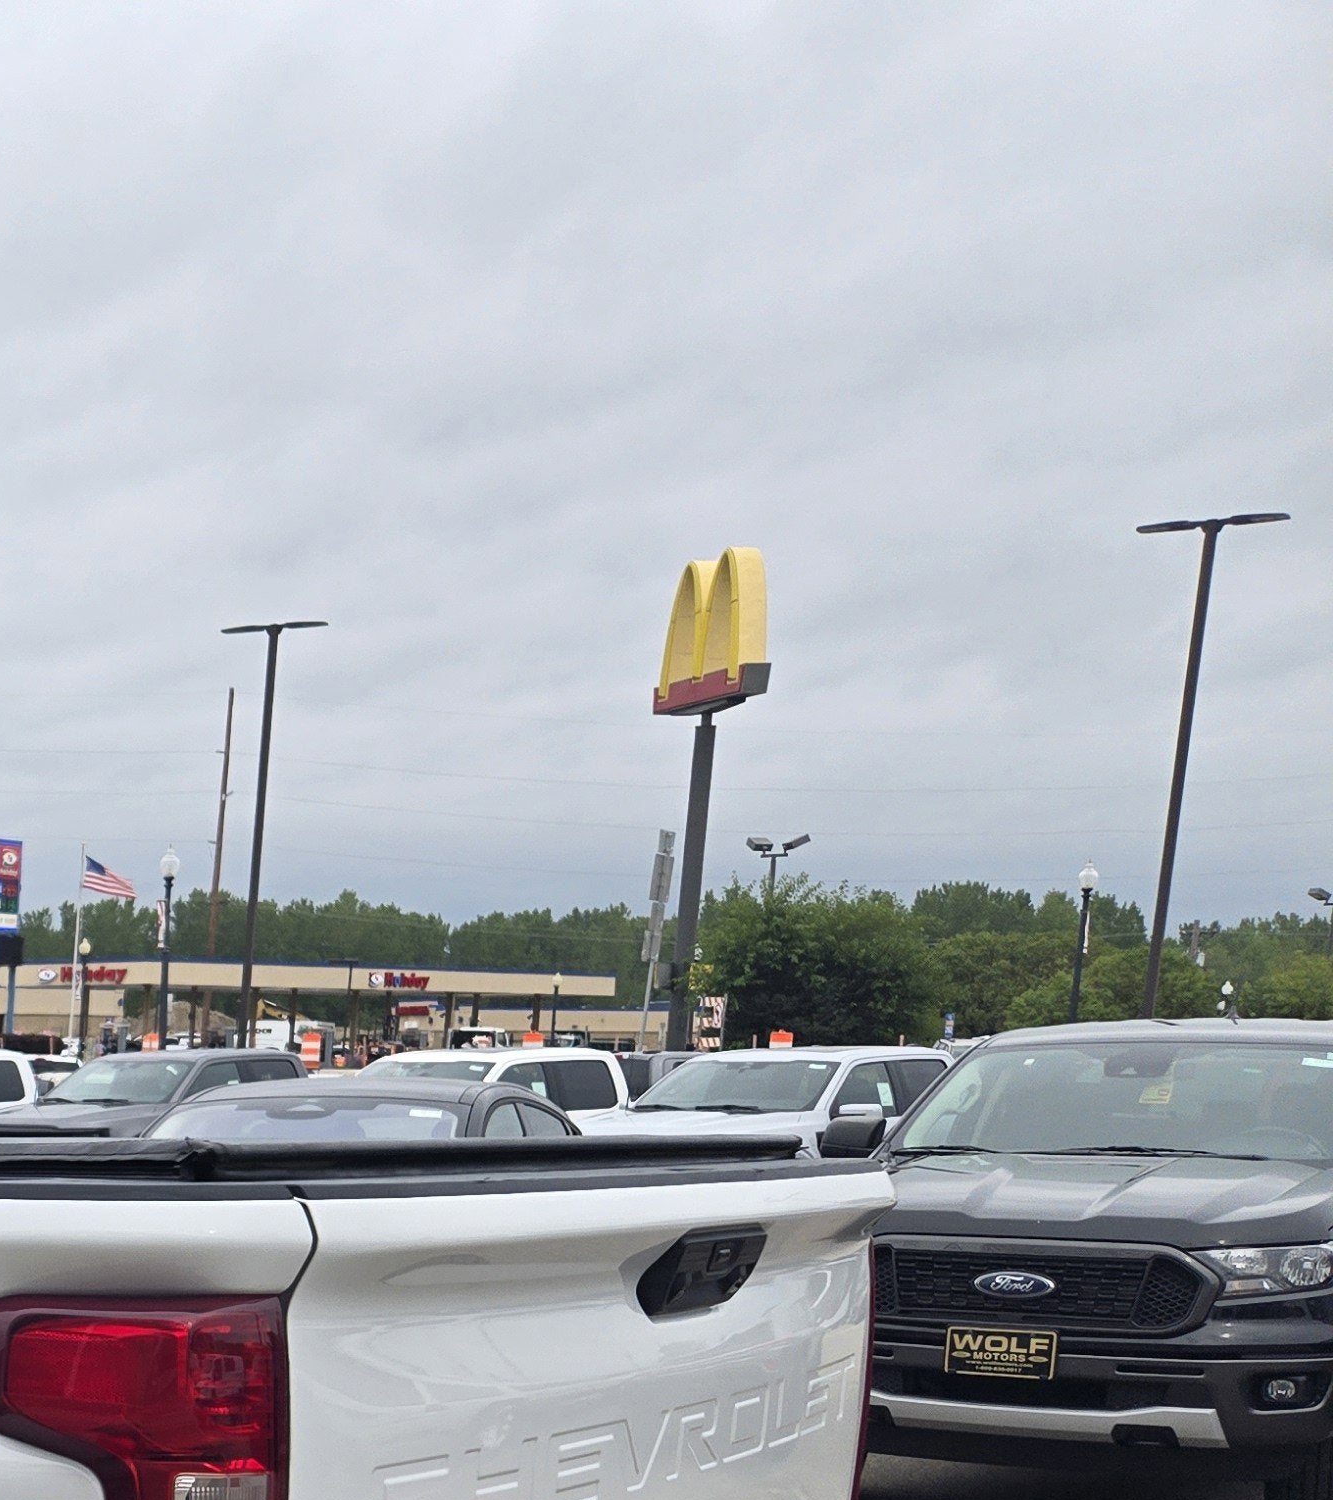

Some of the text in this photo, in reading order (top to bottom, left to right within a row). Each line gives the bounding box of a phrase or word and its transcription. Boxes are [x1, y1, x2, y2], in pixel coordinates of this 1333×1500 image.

[990, 1275, 1035, 1292] Ford
[953, 1333, 1050, 1354] WOLF
[973, 1351, 1026, 1362] MOTORS
